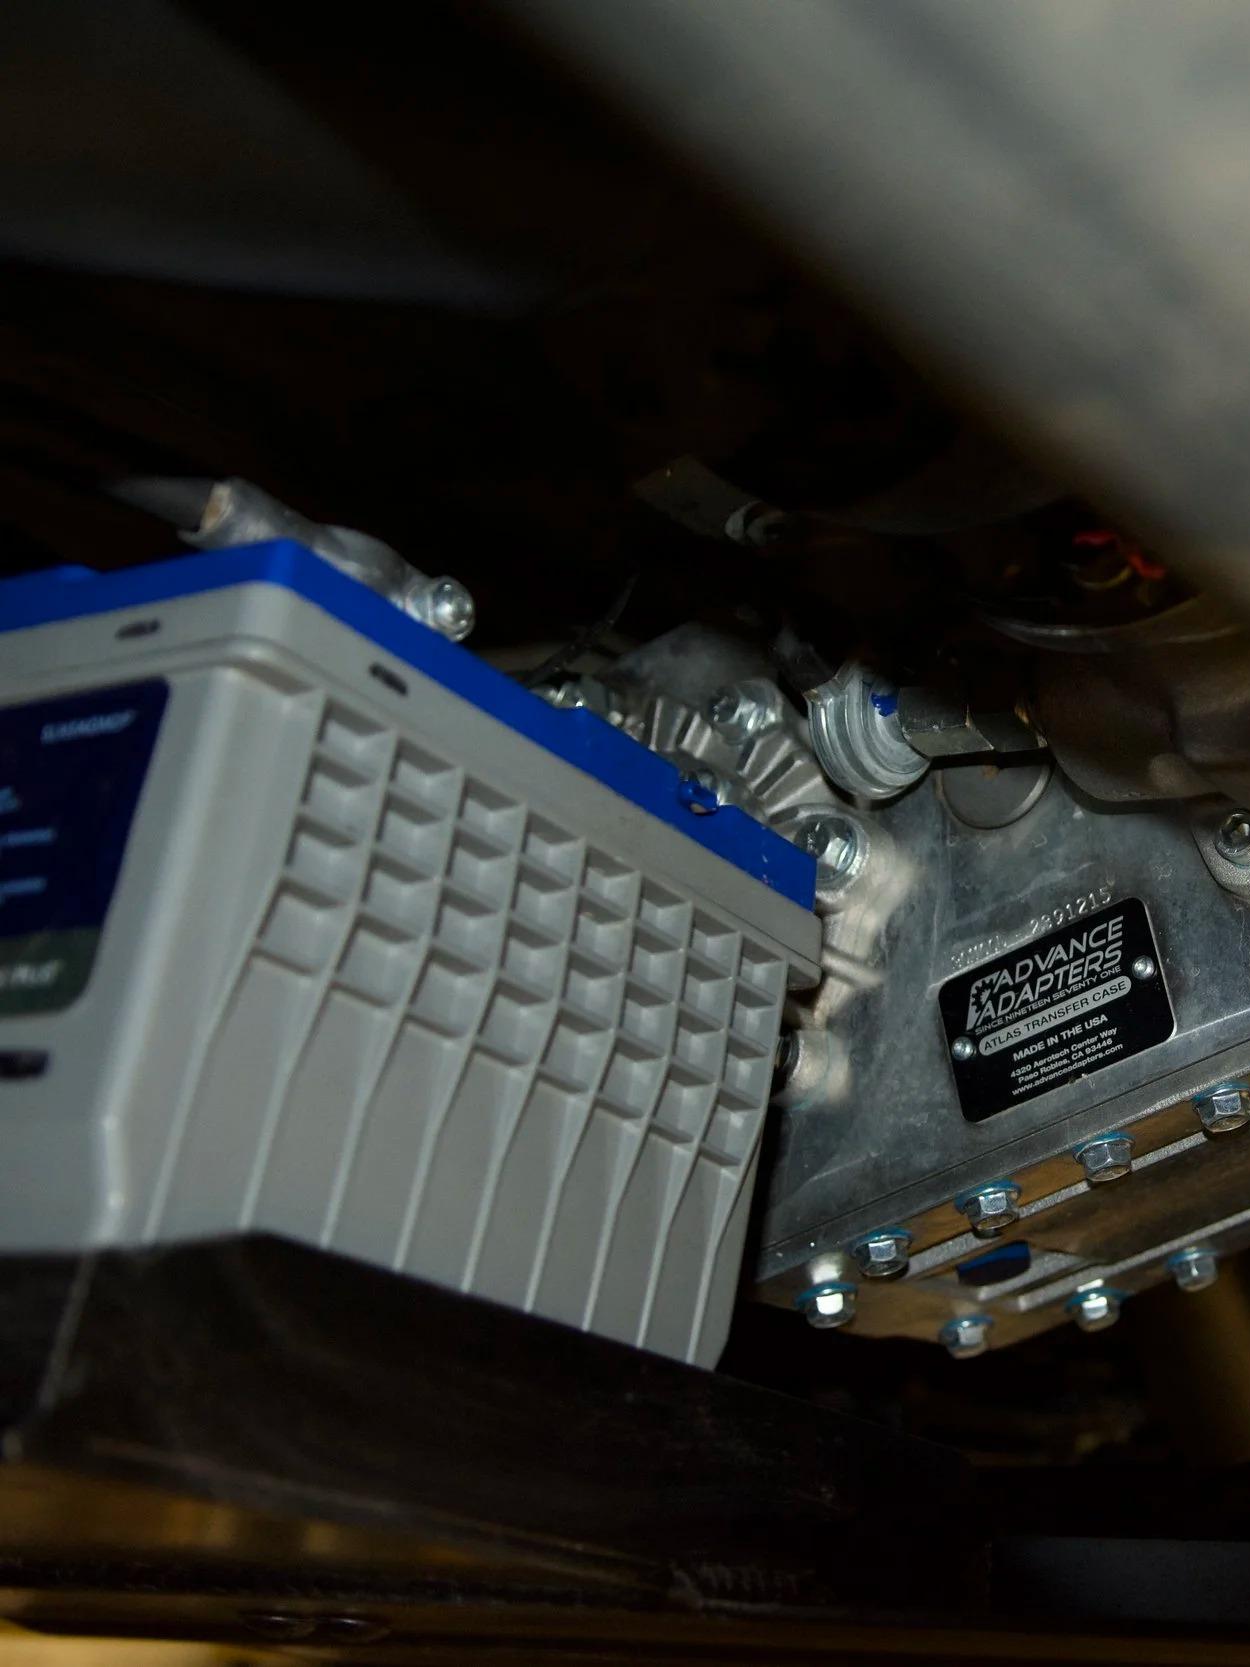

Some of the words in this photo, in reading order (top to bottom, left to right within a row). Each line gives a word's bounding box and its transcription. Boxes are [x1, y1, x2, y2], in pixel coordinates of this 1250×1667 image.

[976, 940, 1123, 1026] ADAPTERS
[992, 915, 1124, 994] ADVANCE
[975, 1018, 1005, 1035] SINCE
[1004, 998, 1050, 1021] NINETEEN
[1052, 974, 1098, 1000] SEVENTY
[1100, 966, 1121, 979] ONE
[984, 1027, 1021, 1051] ATLAS
[1024, 997, 1089, 1032] TRANSFER
[1092, 981, 1127, 1002] CASE
[1010, 1064, 1032, 1078] 4320
[1033, 1048, 1070, 1068] Aerotech
[1071, 1036, 1099, 1052] Center
[1100, 1027, 1118, 1039] Way
[1013, 1040, 1045, 1062] MADE
[1046, 1035, 1059, 1047] IN
[1060, 1024, 1083, 1040] THE
[1085, 1014, 1108, 1030] USA
[1018, 1071, 1039, 1084] Paso
[1039, 1058, 1070, 1075] Robles,
[1071, 1051, 1085, 1061] CA
[1085, 1039, 1113, 1055] 93446
[1011, 1043, 1124, 1096] www.advanceadapters.com
